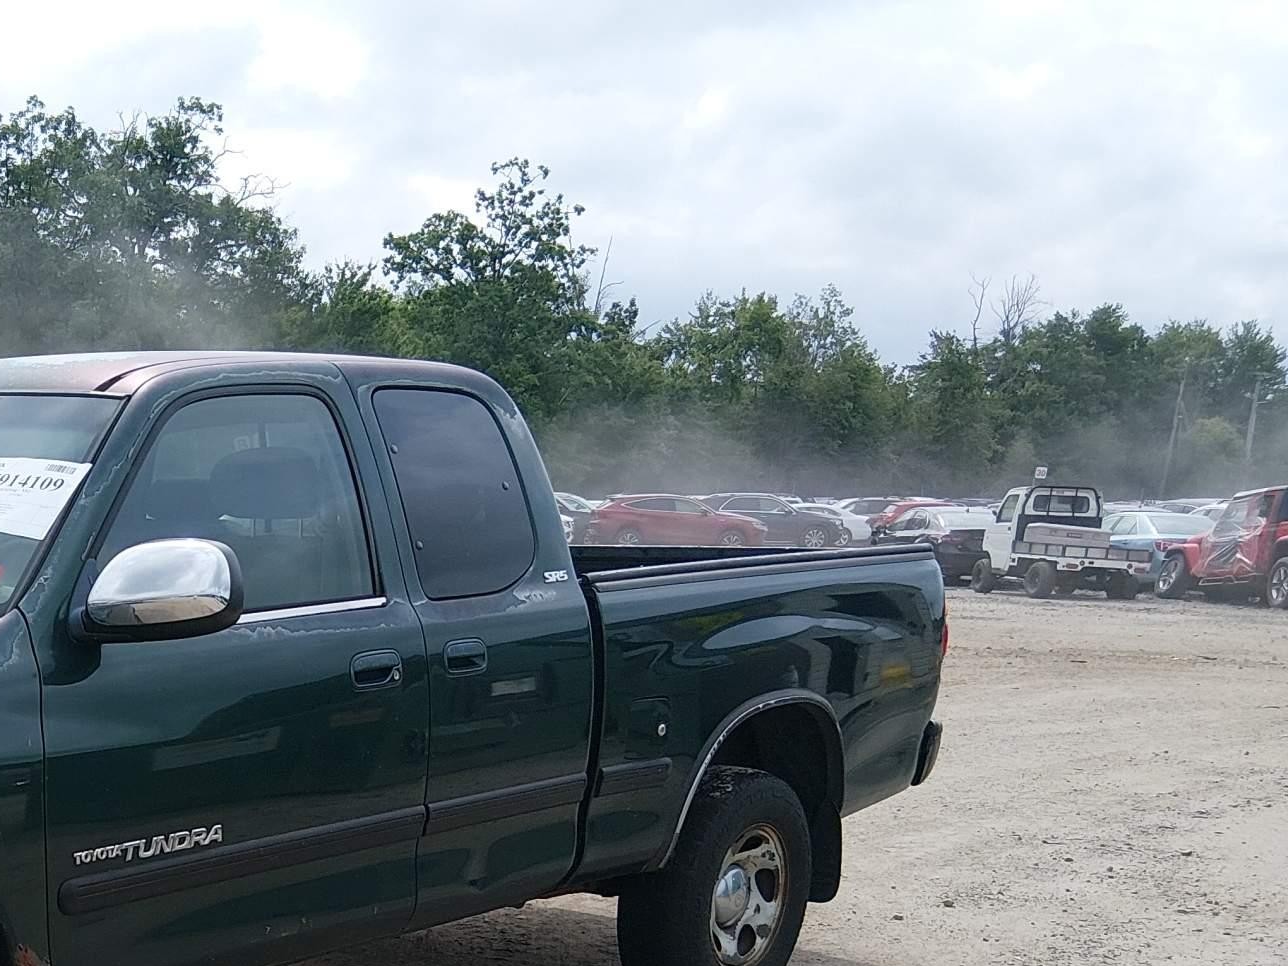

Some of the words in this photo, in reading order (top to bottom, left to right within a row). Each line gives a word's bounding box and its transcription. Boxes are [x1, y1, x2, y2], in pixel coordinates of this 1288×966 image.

[543, 570, 569, 583] SR5
[73, 845, 122, 865] TOYOTA
[121, 824, 223, 861] TUNDRA
